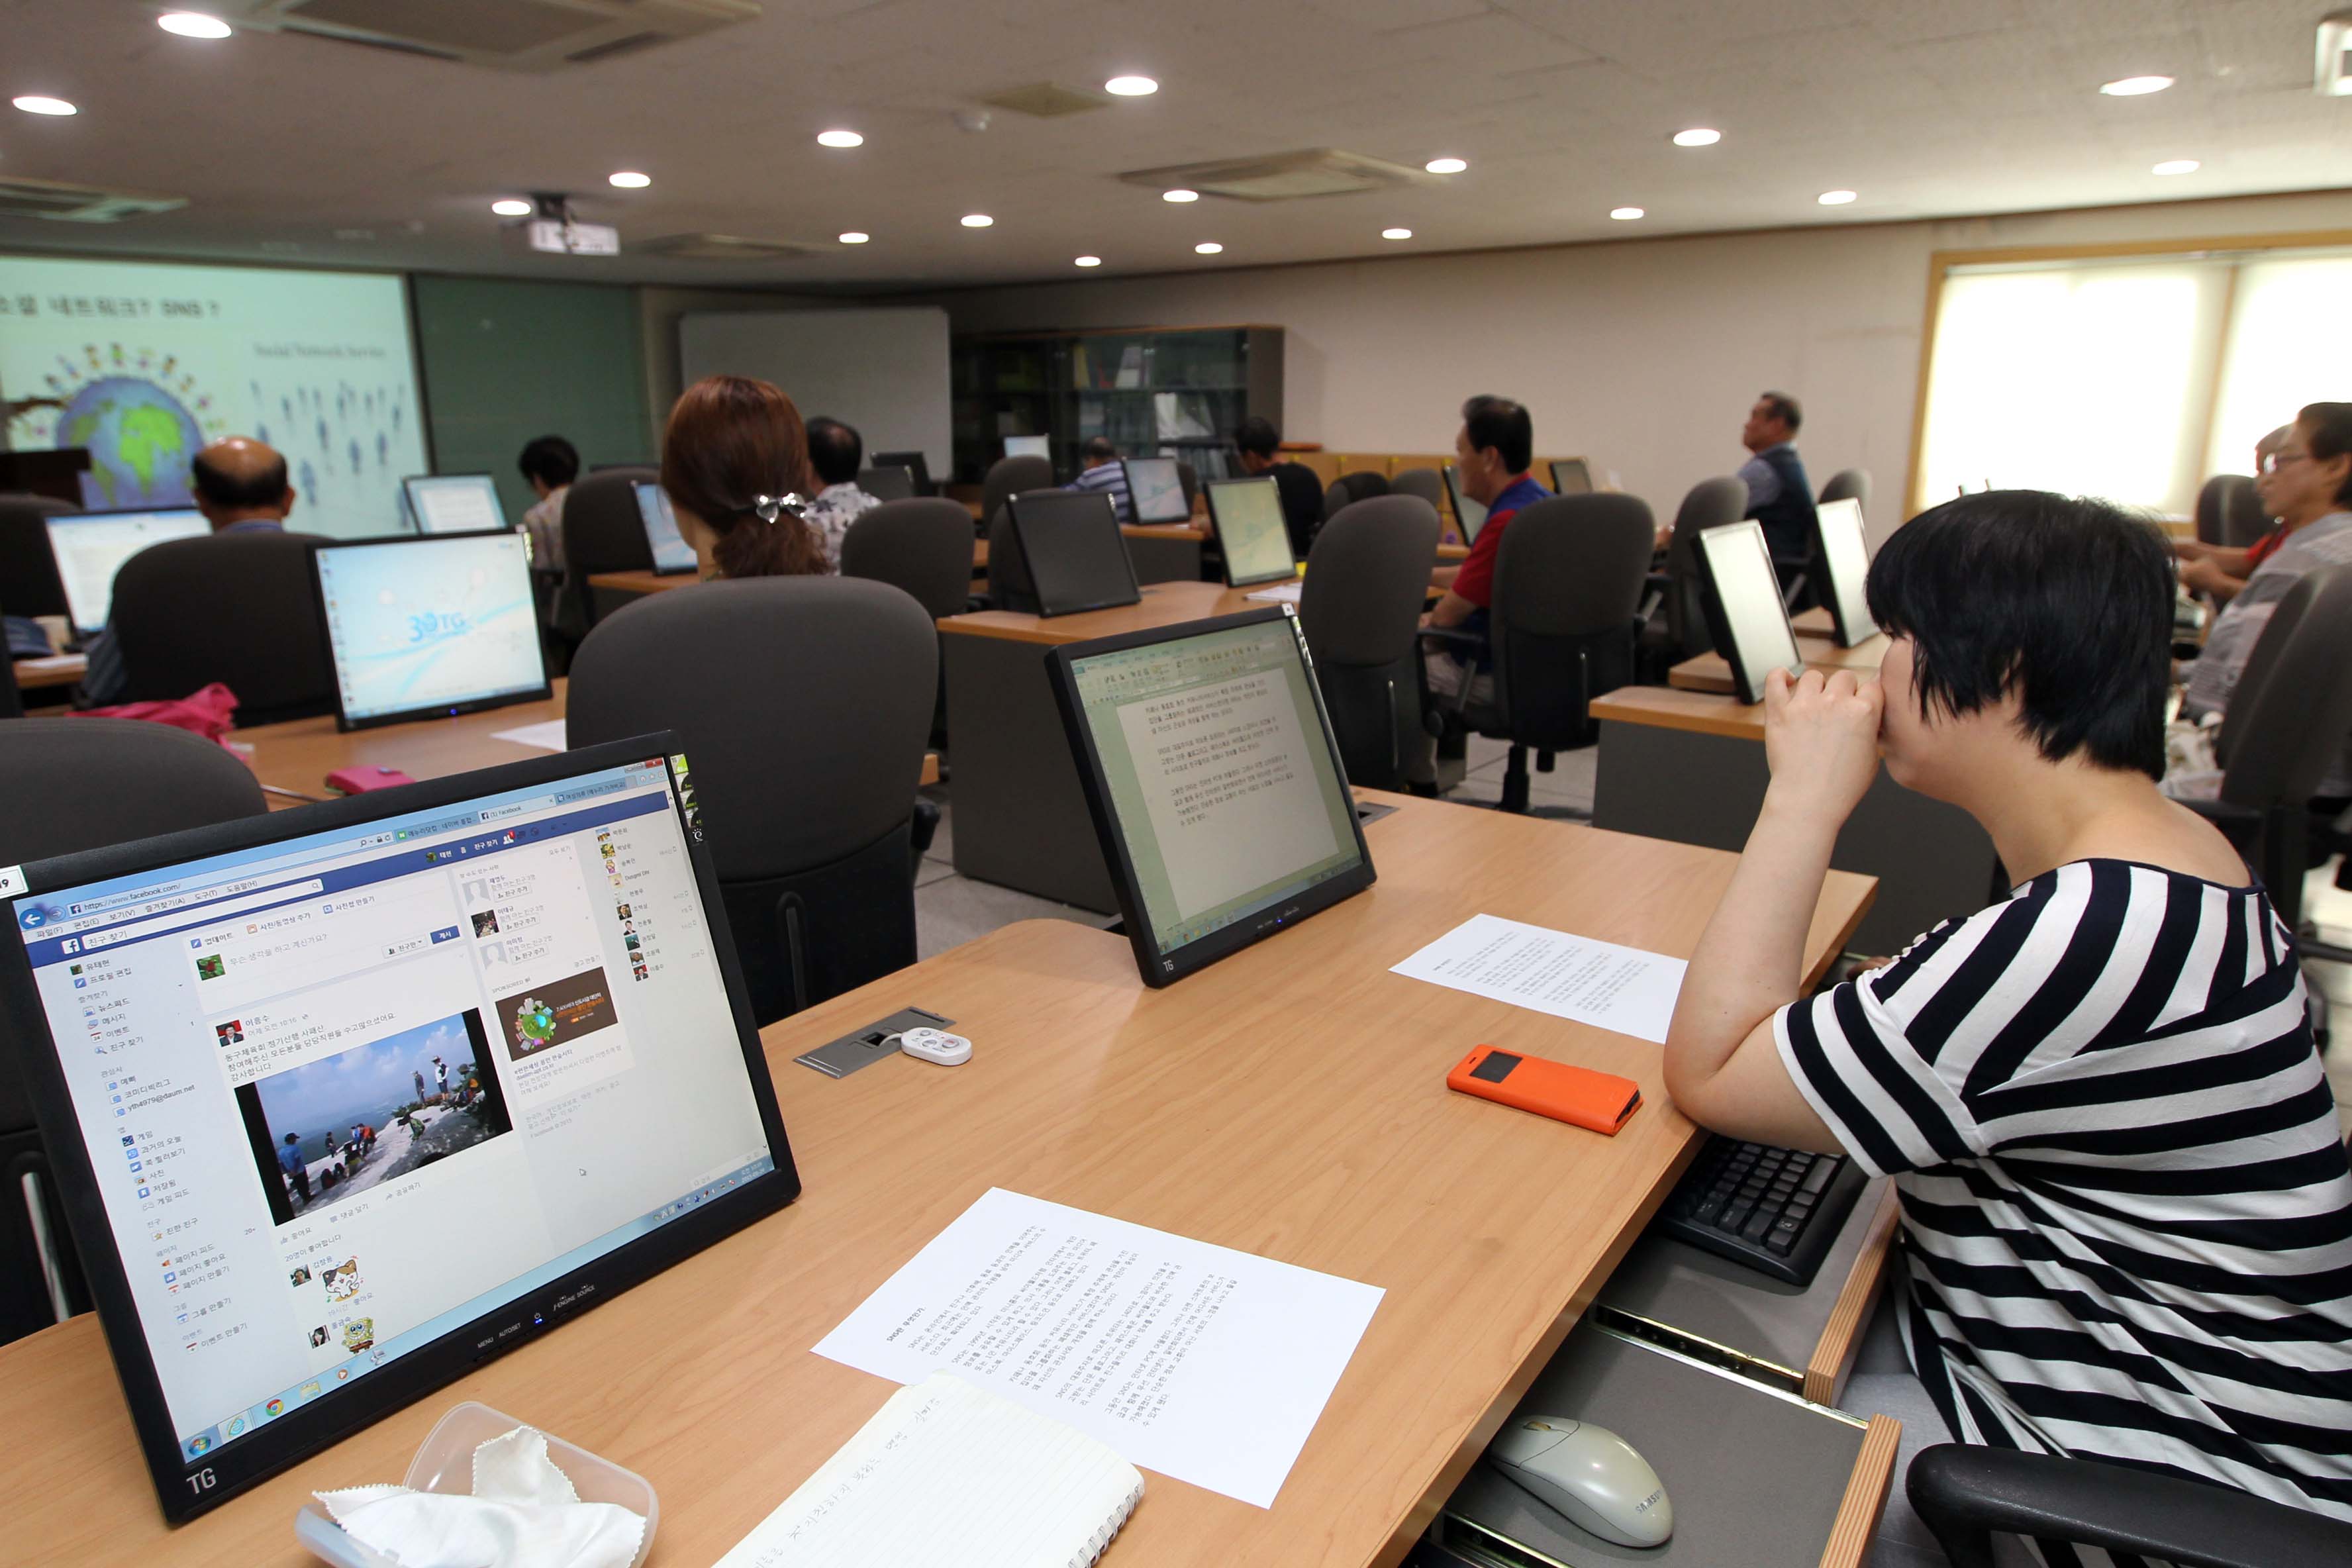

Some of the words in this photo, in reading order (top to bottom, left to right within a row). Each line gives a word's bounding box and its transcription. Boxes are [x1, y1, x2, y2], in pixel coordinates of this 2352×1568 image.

[87, 934, 108, 948] 친구
[108, 930, 128, 942] 찾기
[273, 942, 291, 955] 하고
[1163, 959, 1174, 972] TG
[97, 996, 131, 1012] 뉴스피드
[101, 1012, 126, 1026] 메시지
[105, 1025, 131, 1040] 이벤트
[109, 1040, 129, 1052] 친구
[127, 1036, 144, 1047] 찾기
[186, 1467, 217, 1494] TG
